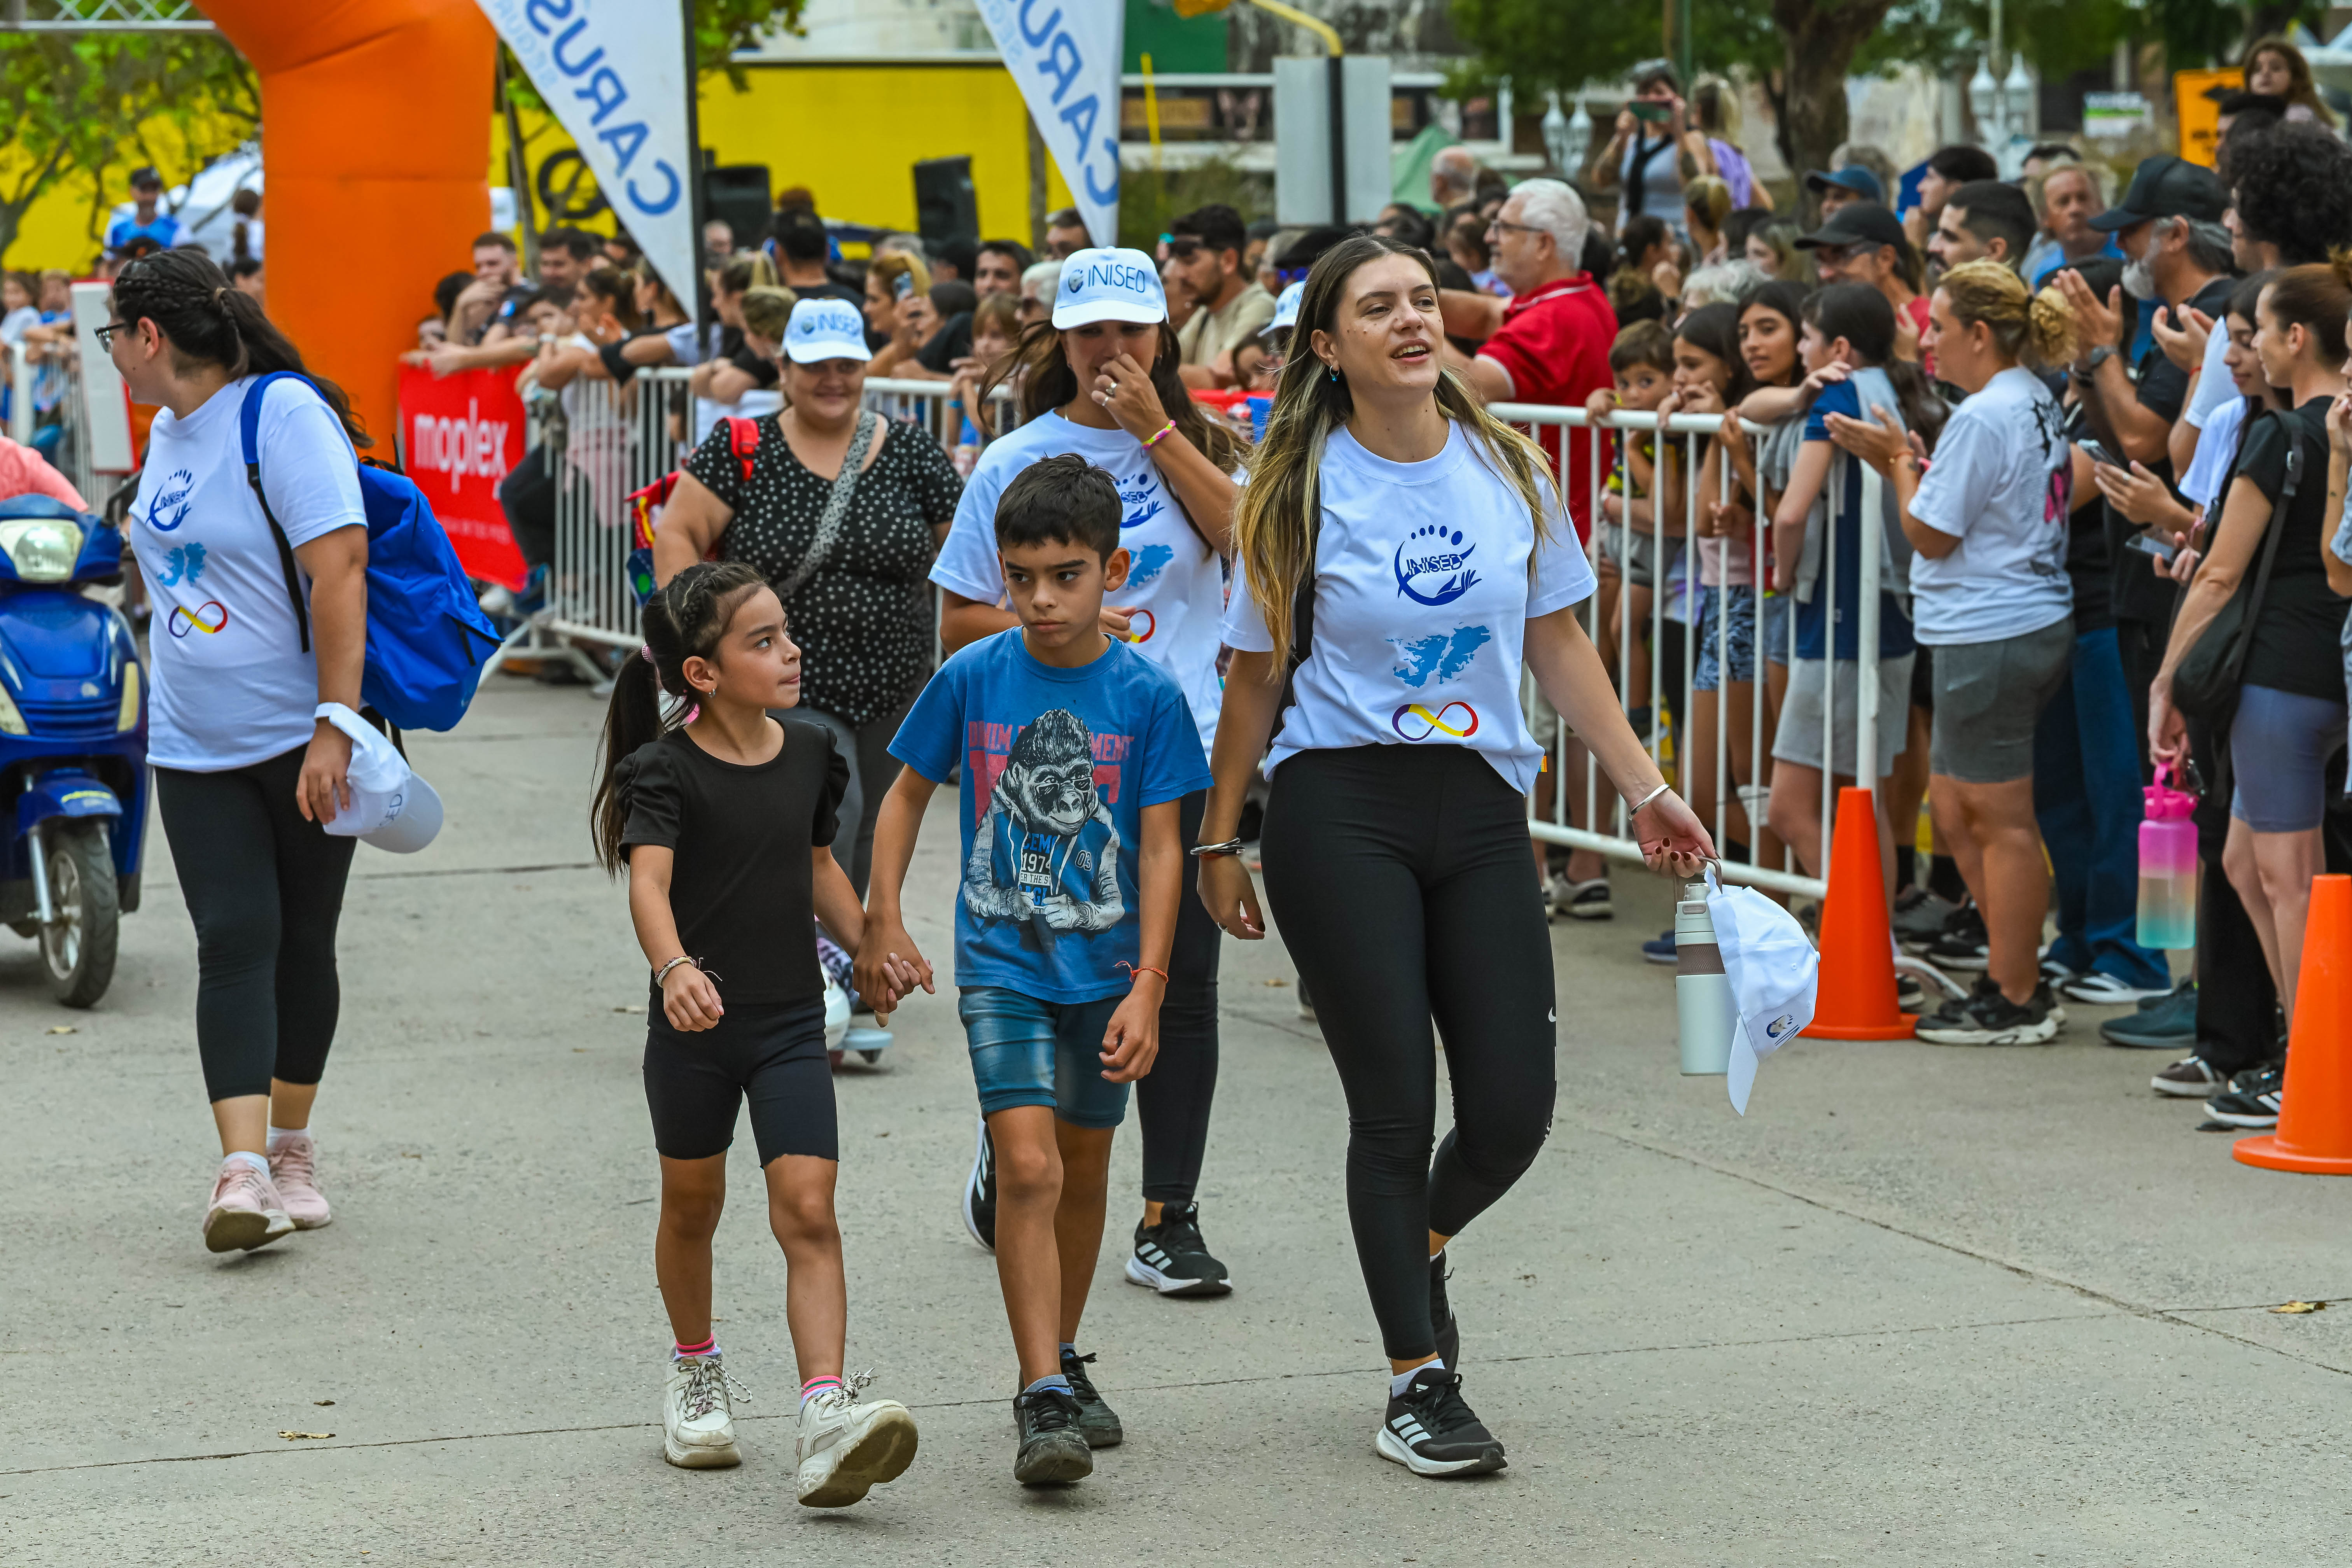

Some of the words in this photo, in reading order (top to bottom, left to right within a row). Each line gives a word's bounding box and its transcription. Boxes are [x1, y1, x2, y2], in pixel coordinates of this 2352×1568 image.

[1088, 264, 1146, 293] INISED
[414, 396, 509, 494] moplex
[1406, 553, 1463, 575] INISED
[1075, 850, 1092, 871] 03
[1030, 874, 1043, 884] THE
